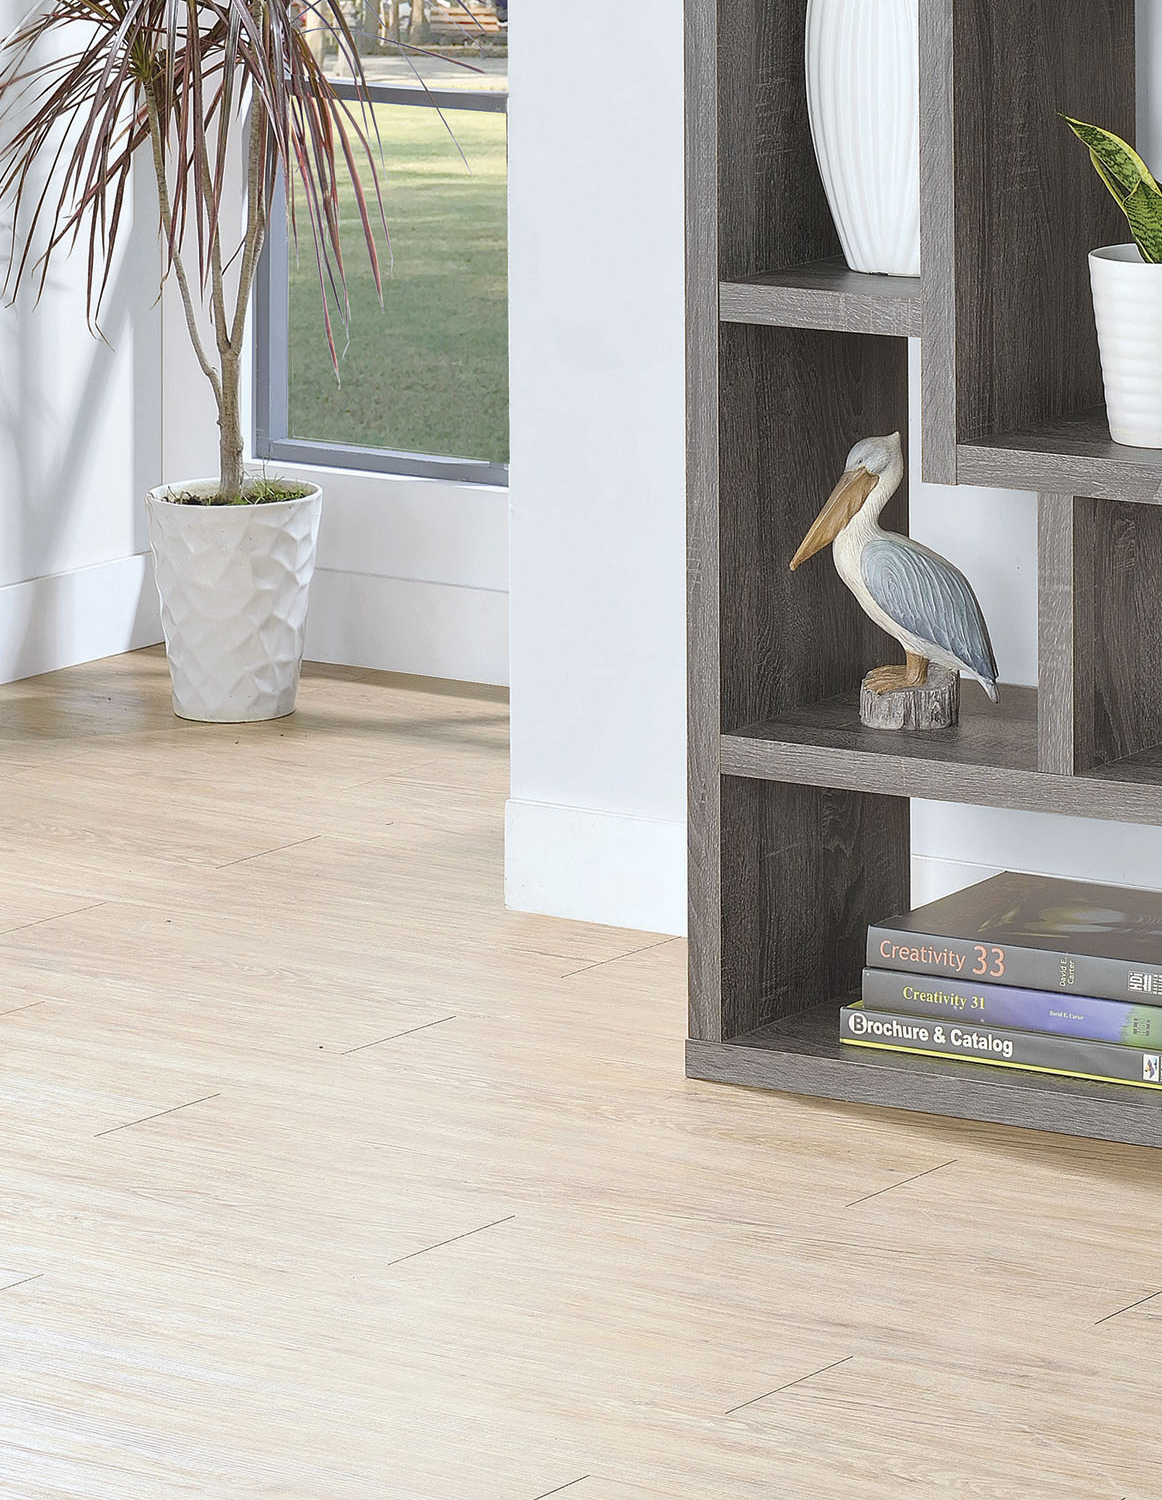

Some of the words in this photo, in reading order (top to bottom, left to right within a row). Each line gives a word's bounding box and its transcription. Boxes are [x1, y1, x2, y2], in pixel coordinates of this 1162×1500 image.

[880, 940, 966, 972] Creativity
[972, 945, 1006, 977] 33
[1059, 965, 1067, 987] David
[1067, 960, 1075, 985] Carter
[903, 986, 967, 1010] Creativity
[970, 996, 985, 1010] 31
[848, 1012, 929, 1041] Brochure
[933, 1026, 947, 1045] &
[950, 1029, 1013, 1058] Catalog
